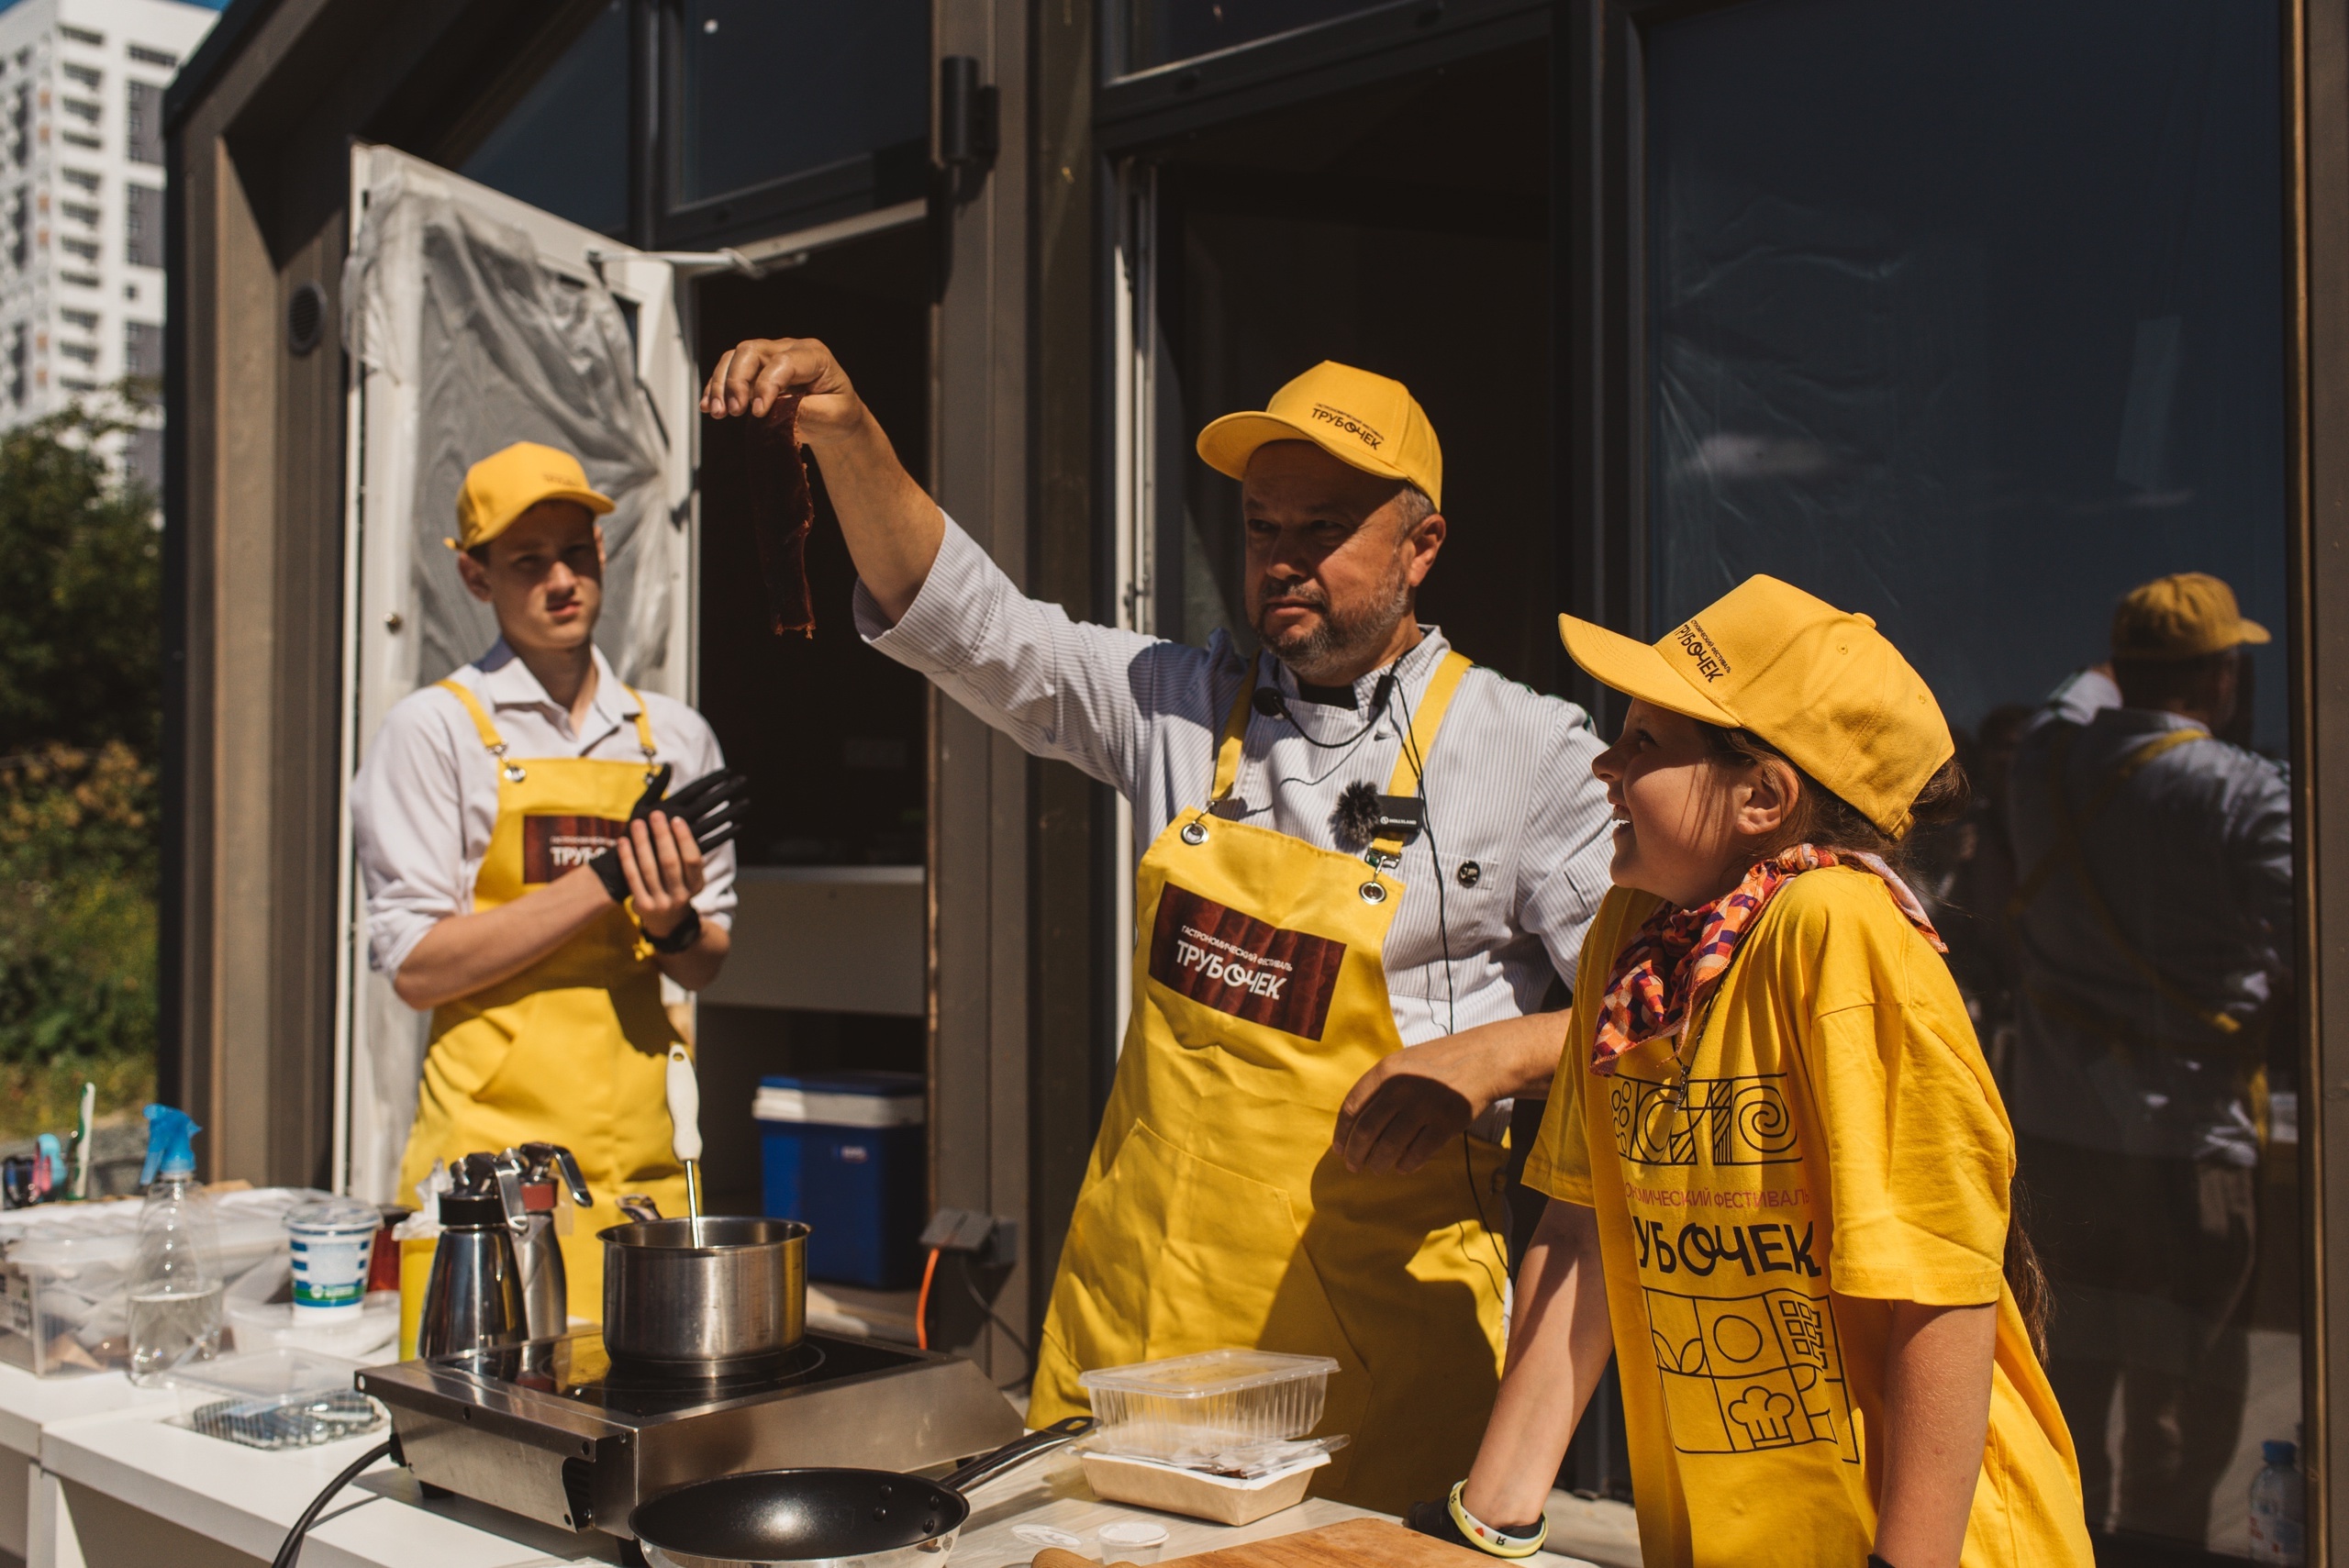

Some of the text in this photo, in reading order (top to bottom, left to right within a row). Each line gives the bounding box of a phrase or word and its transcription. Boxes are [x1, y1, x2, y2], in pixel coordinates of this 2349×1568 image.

[1311, 407, 1382, 450] ТРУБОЧЕК
[1176, 940, 1287, 1000] ТРУБОЧЕК
[1181, 925, 1293, 972] ГАСТРОНОМИЧЕСКИЙ ФЕСТИВАЛЬ
[1624, 1183, 1810, 1209] ОНОМИЧЕСКИЙ ФЕСТИВАЛЬ
[1632, 1216, 1822, 1278] УБОЧЕК
